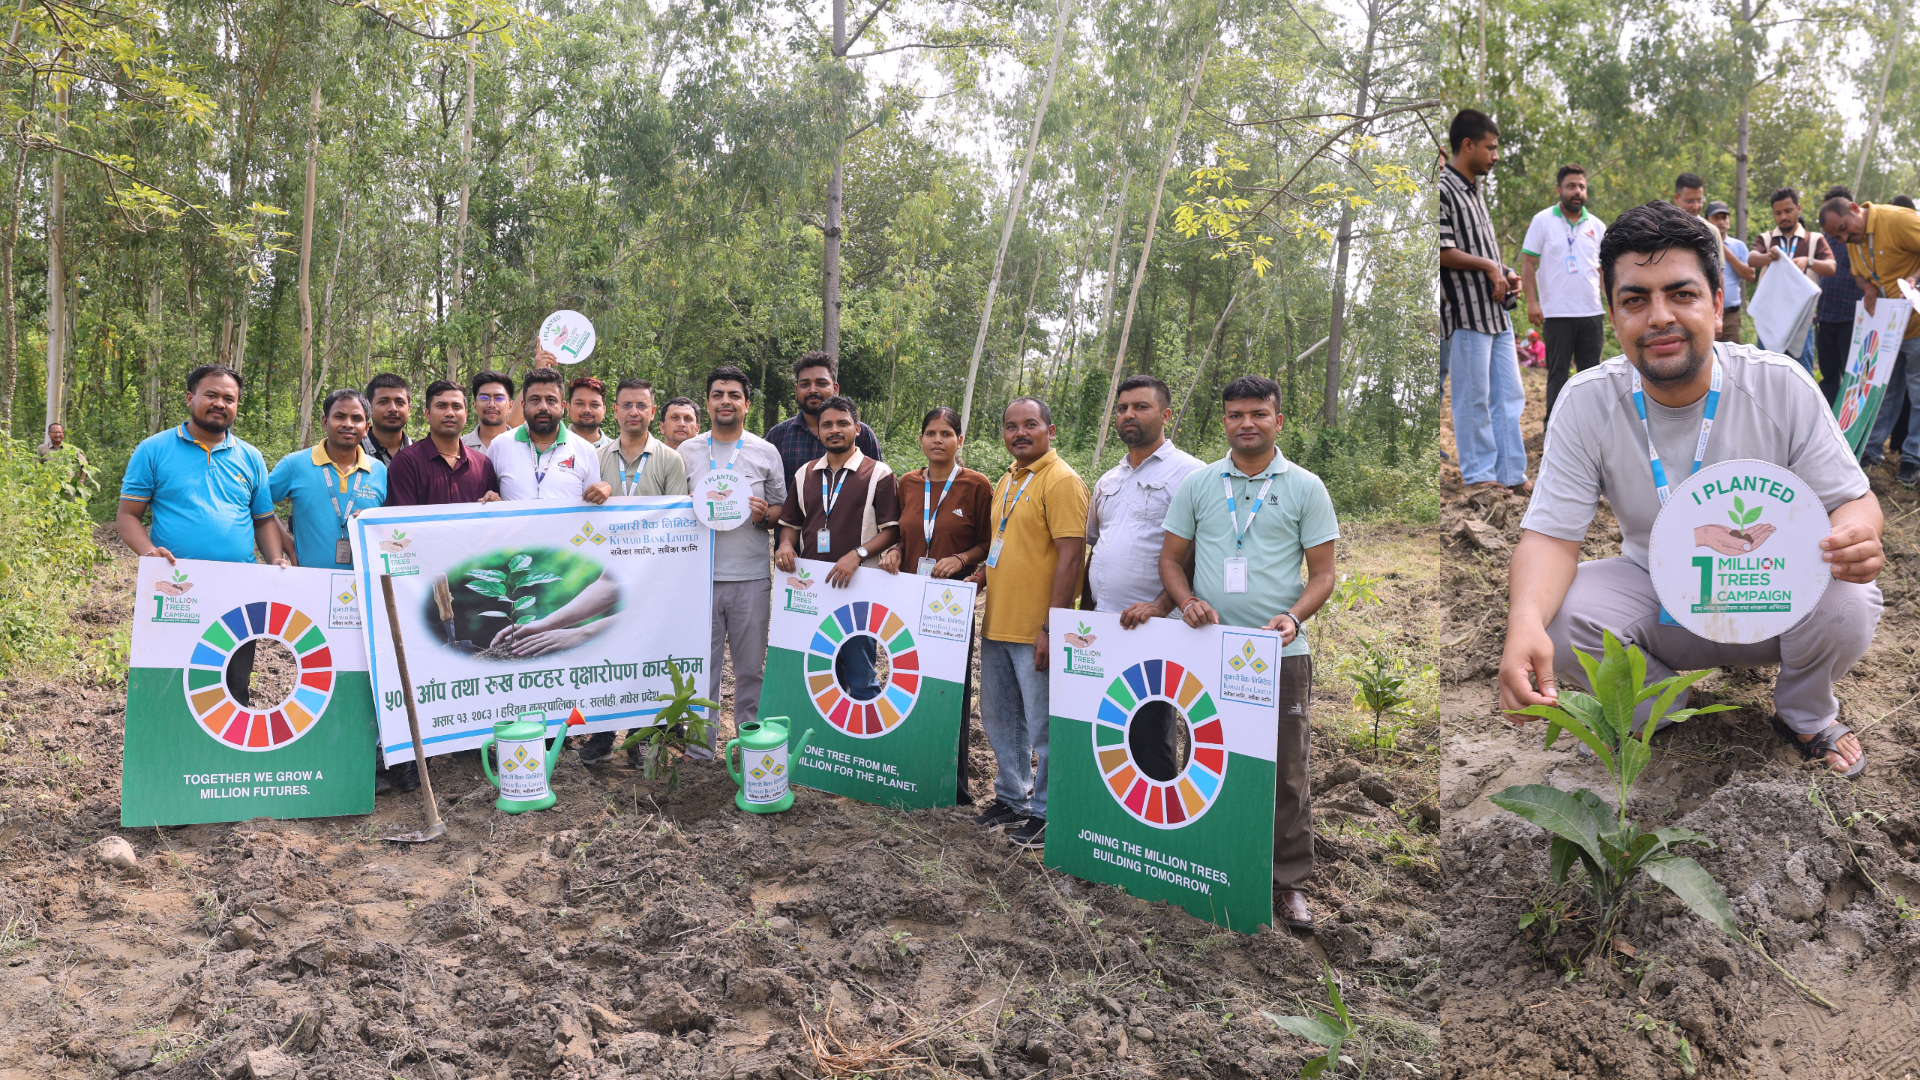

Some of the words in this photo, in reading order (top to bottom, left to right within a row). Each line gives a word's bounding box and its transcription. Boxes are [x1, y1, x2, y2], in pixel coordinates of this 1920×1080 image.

[544, 315, 561, 337] PLANTED
[707, 474, 739, 483] PLANTED
[1691, 491, 1702, 505] I
[1702, 475, 1795, 504] PLANTED
[609, 520, 640, 533] कुमारी
[661, 517, 698, 529] लिमिटेड
[609, 535, 641, 545] KUMARI
[643, 534, 665, 544] BANK
[667, 533, 699, 543] LIMITED
[1691, 556, 1713, 604] 1
[1717, 557, 1785, 571] MILLION
[1717, 573, 1771, 586] TREES
[793, 590, 818, 599] MILLION
[793, 596, 811, 604] TREES
[1717, 590, 1791, 602] CAMPAIGN
[153, 595, 164, 619] 1
[165, 596, 198, 604] MILLION
[165, 603, 190, 611] TREES
[793, 603, 818, 611] CAMPAIGN
[1064, 646, 1072, 670] 1
[1074, 649, 1101, 657] MILLION
[1074, 656, 1095, 664] TREES
[1074, 664, 1104, 672] CAMPAIGN
[385, 690, 408, 712] ५०
[451, 677, 480, 700] तथा
[518, 668, 565, 690] कटहर
[569, 659, 638, 690] वृक्षारोपण
[432, 714, 455, 728] असार
[472, 709, 492, 721] २०८३
[620, 691, 639, 704] मधेस
[804, 744, 825, 757] ONE
[827, 749, 851, 764] TREE
[853, 756, 880, 771] FROM
[882, 764, 900, 778] ME,
[183, 772, 251, 785] TOGETHER
[254, 772, 273, 782] WE
[276, 770, 313, 782] GROW
[315, 770, 323, 780] A
[799, 757, 832, 772] ILLION
[834, 765, 854, 777] FOR
[856, 770, 875, 783] THE
[877, 775, 918, 793] PLANET.
[200, 787, 250, 799] MILLION
[253, 785, 310, 797] FUTURES.
[1078, 829, 1119, 850] JOINING
[1122, 840, 1142, 857] THE
[1144, 848, 1187, 872] MILLION
[1190, 862, 1231, 887] TREES,
[1093, 848, 1142, 872] BUILDING
[1144, 864, 1212, 896] TOMORROW.
